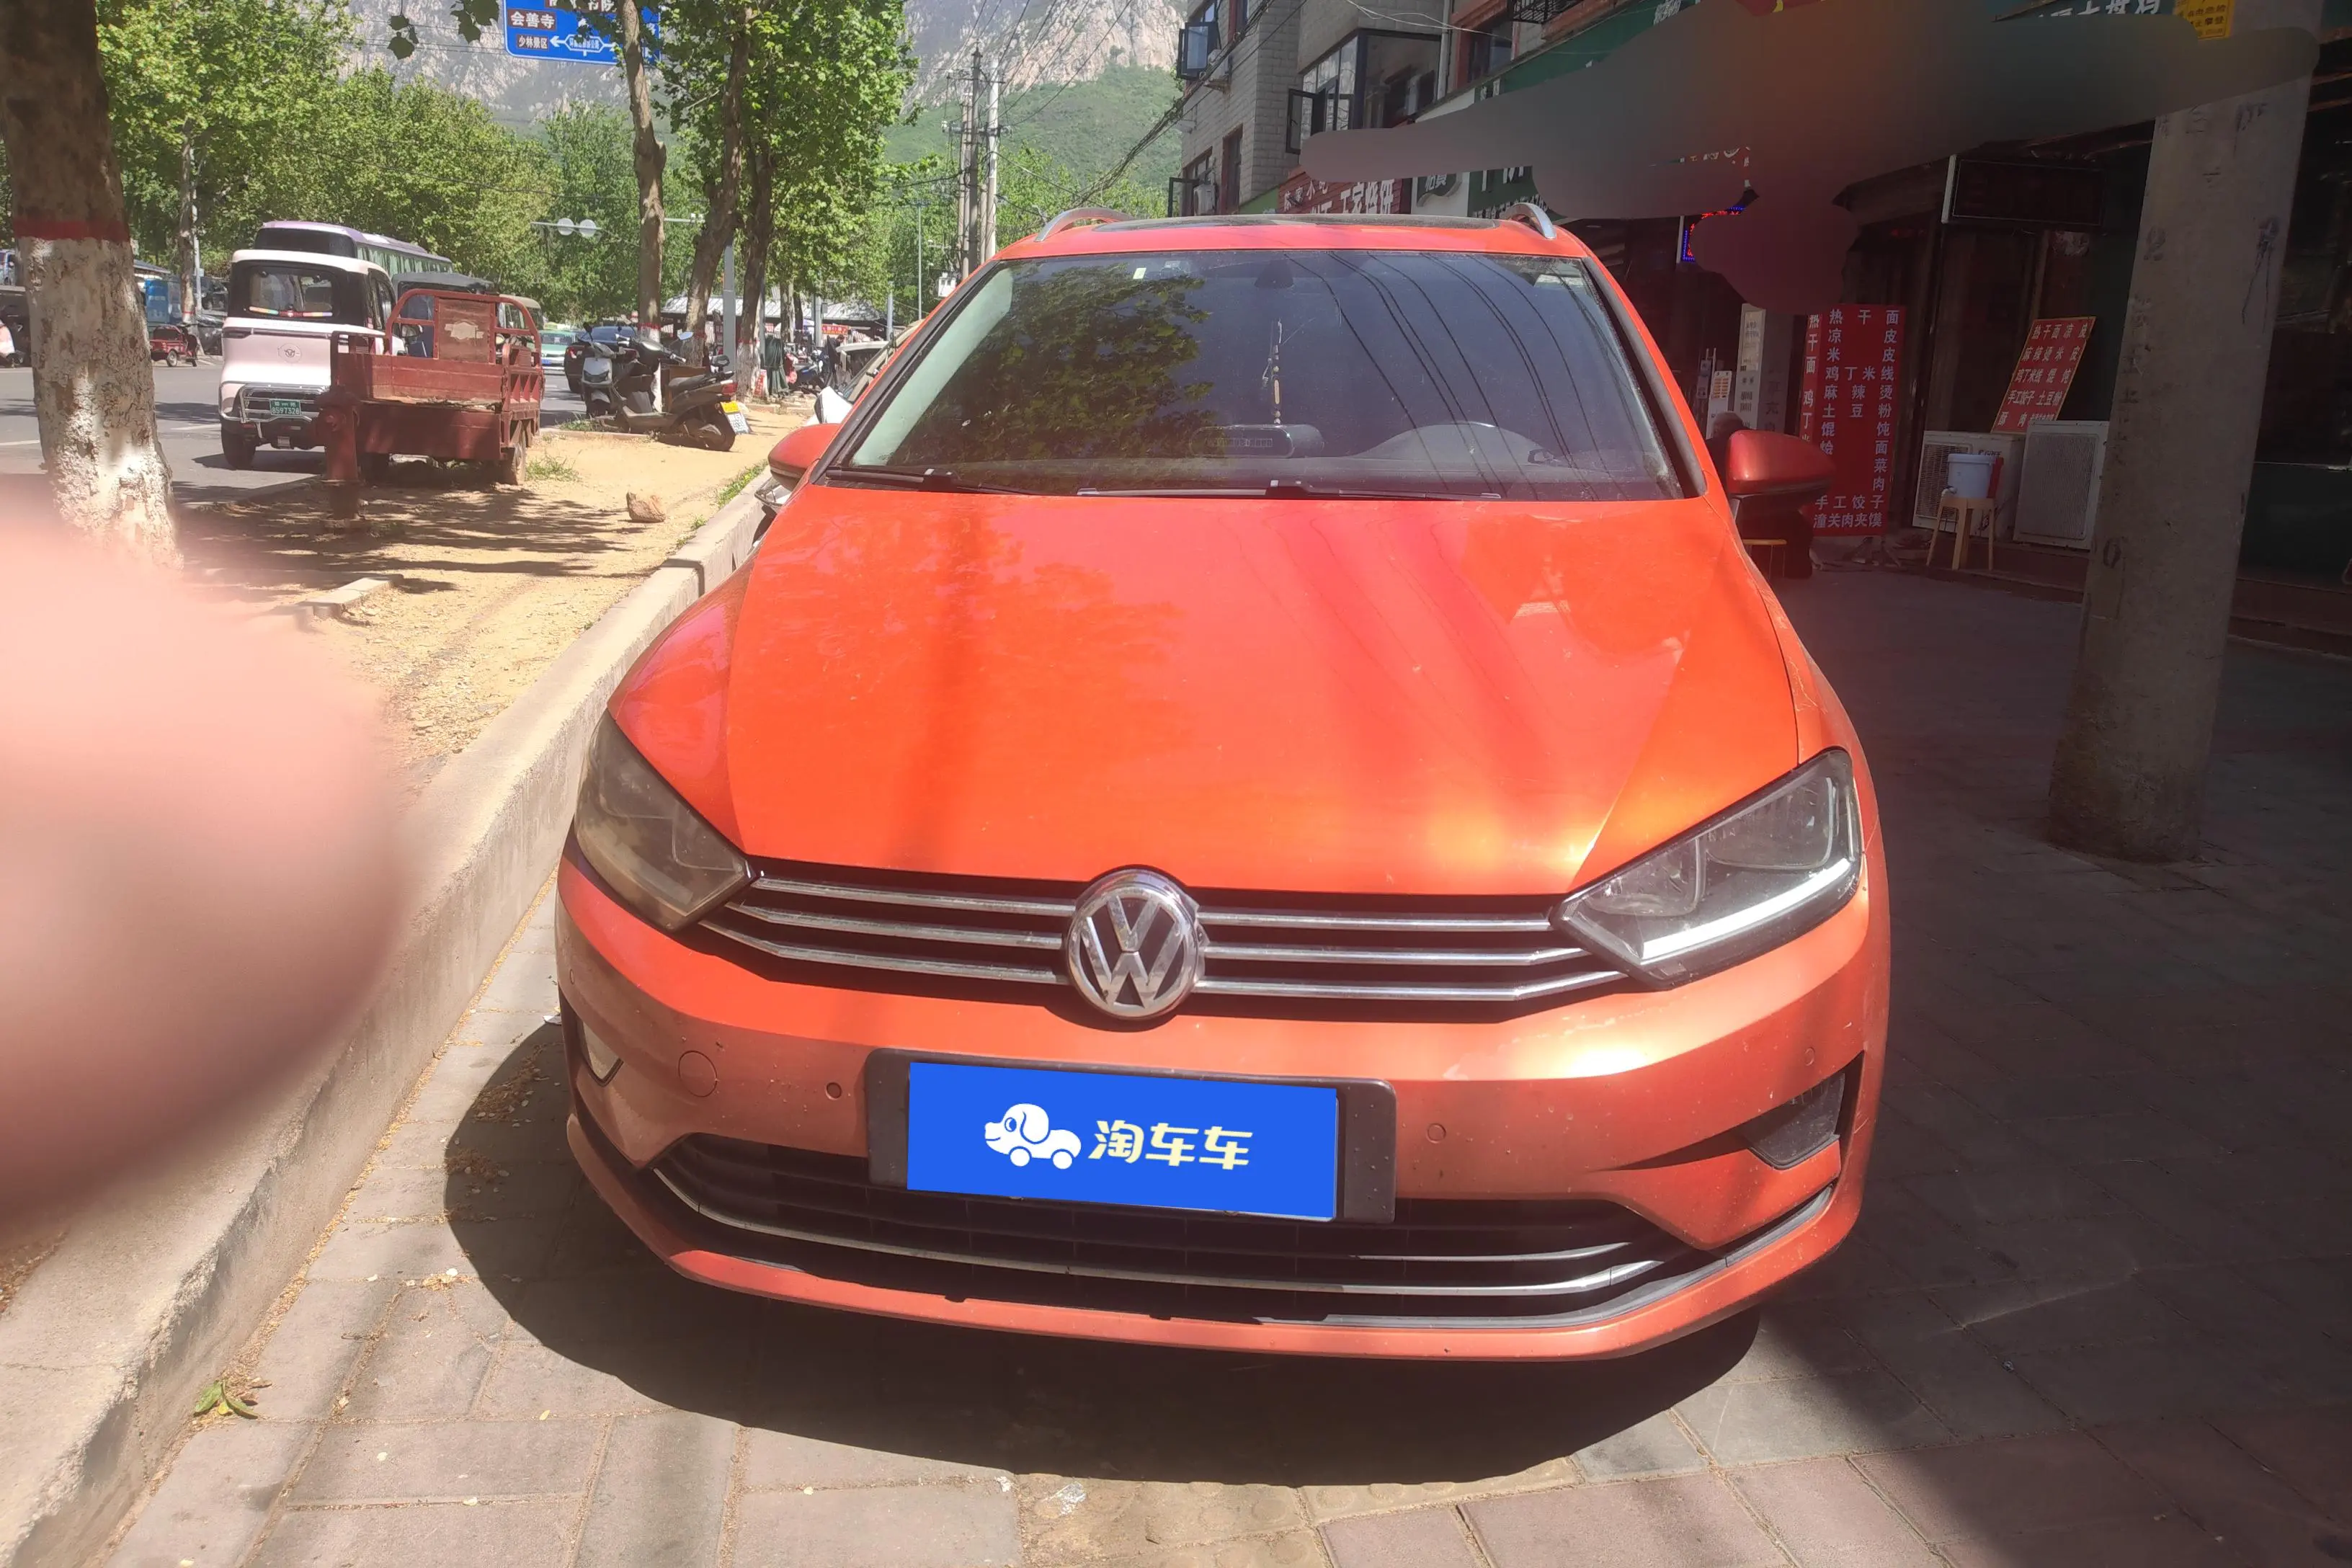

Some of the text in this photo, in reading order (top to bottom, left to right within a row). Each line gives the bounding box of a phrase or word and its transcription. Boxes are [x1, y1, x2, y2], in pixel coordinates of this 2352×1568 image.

[510, 12, 556, 30] 会善寺
[519, 37, 548, 49] 少林景区
[1829, 308, 1900, 325] 热干面
[1828, 328, 1897, 344] 凉皮
[1827, 347, 1896, 362] 米皮
[1825, 365, 1894, 381] 鸡丁米线
[1824, 384, 1893, 400] 麻辣烫
[1822, 403, 1892, 419] 土豆粉
[1814, 494, 1884, 510] 手工饺子
[1813, 512, 1883, 529] 潼关肉夹馍
